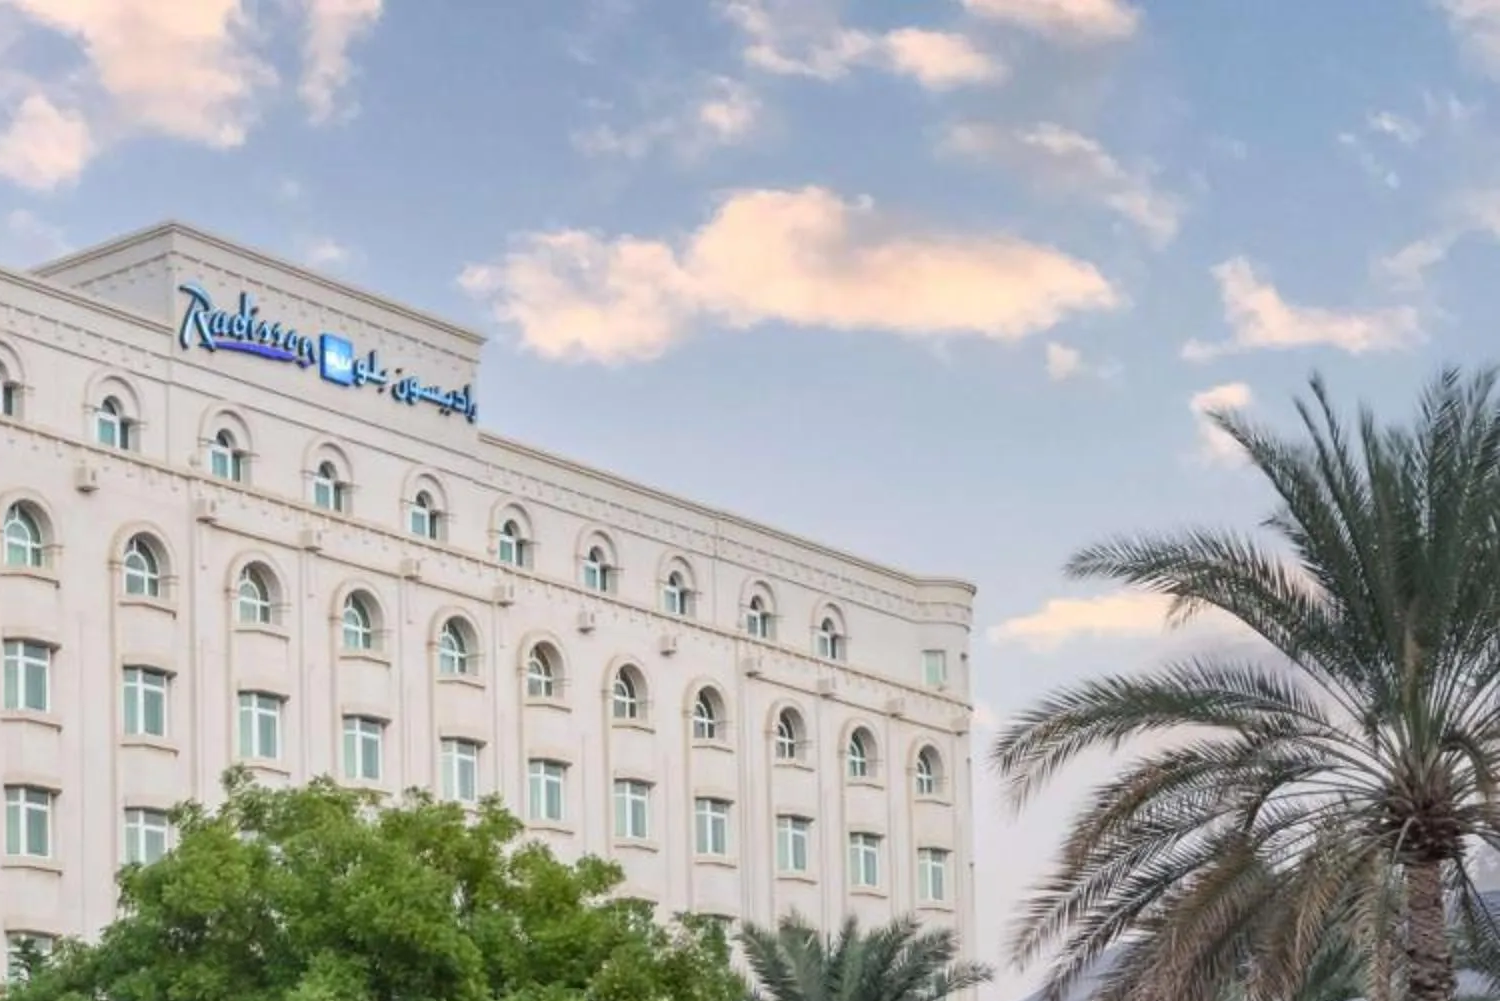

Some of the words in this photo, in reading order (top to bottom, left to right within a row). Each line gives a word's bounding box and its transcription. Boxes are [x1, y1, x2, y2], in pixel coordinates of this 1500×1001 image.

[178, 282, 316, 369] Radisson
[352, 348, 388, 394] بلو
[391, 367, 477, 424] راديسون
